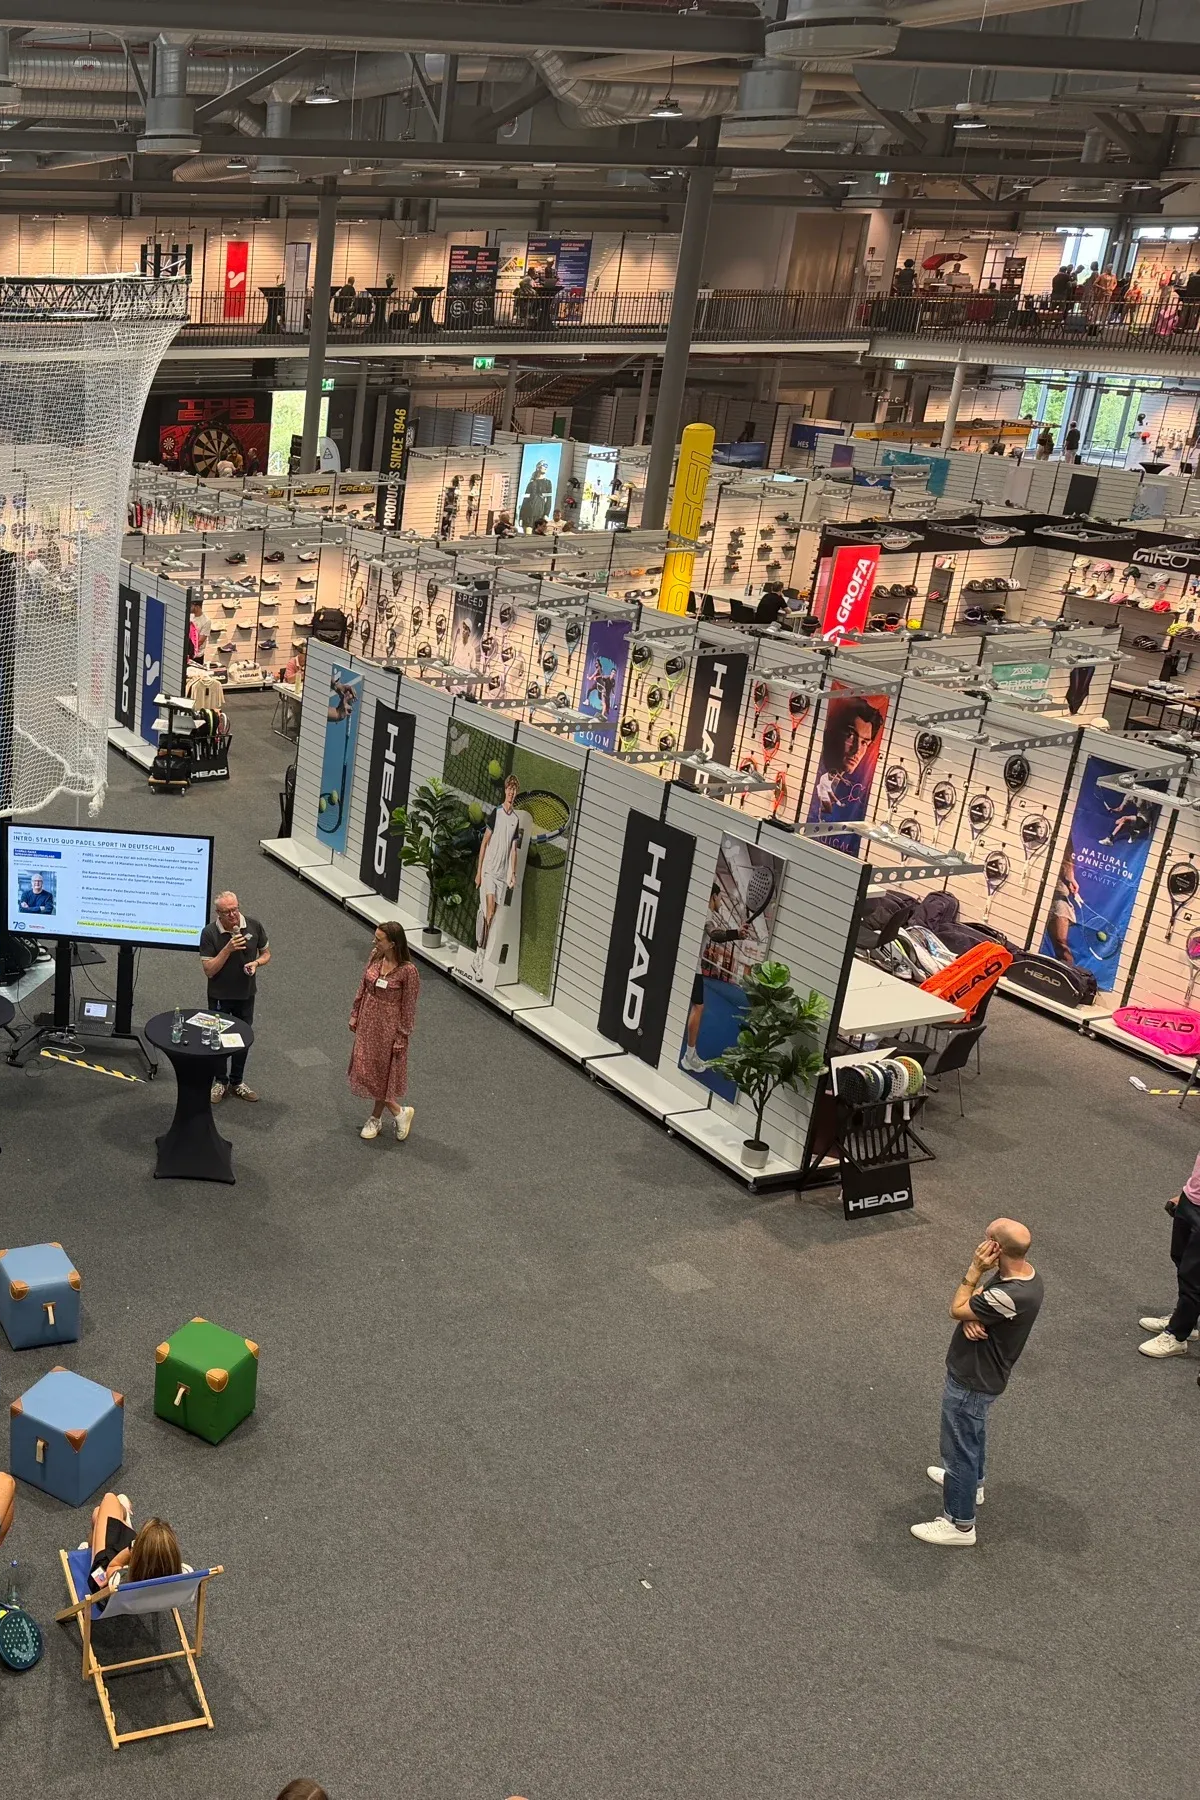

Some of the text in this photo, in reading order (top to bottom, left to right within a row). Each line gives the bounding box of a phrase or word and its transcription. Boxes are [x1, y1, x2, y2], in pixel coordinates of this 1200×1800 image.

[384, 408, 407, 527] PRODUCS SINCE 1946
[1132, 548, 1190, 568] GIRO
[457, 592, 484, 608] SPEED
[836, 558, 872, 623] GROFA
[121, 599, 133, 713] HEAD
[579, 731, 610, 748] BOOM
[190, 767, 228, 780] HEAD
[373, 722, 400, 876] HEAD
[75, 839, 96, 847] PADEL
[128, 843, 175, 852] DEUTSCHLAND
[813, 836, 853, 853] DICAL
[1071, 852, 1134, 880] CONNECTION
[1082, 847, 1128, 869] NATURAL
[1081, 870, 1118, 888] GRAVITY
[622, 841, 668, 1031] HEAD
[1024, 967, 1061, 988] HEAD
[1123, 1013, 1195, 1034] HEAD
[848, 1189, 910, 1212] HEAD
